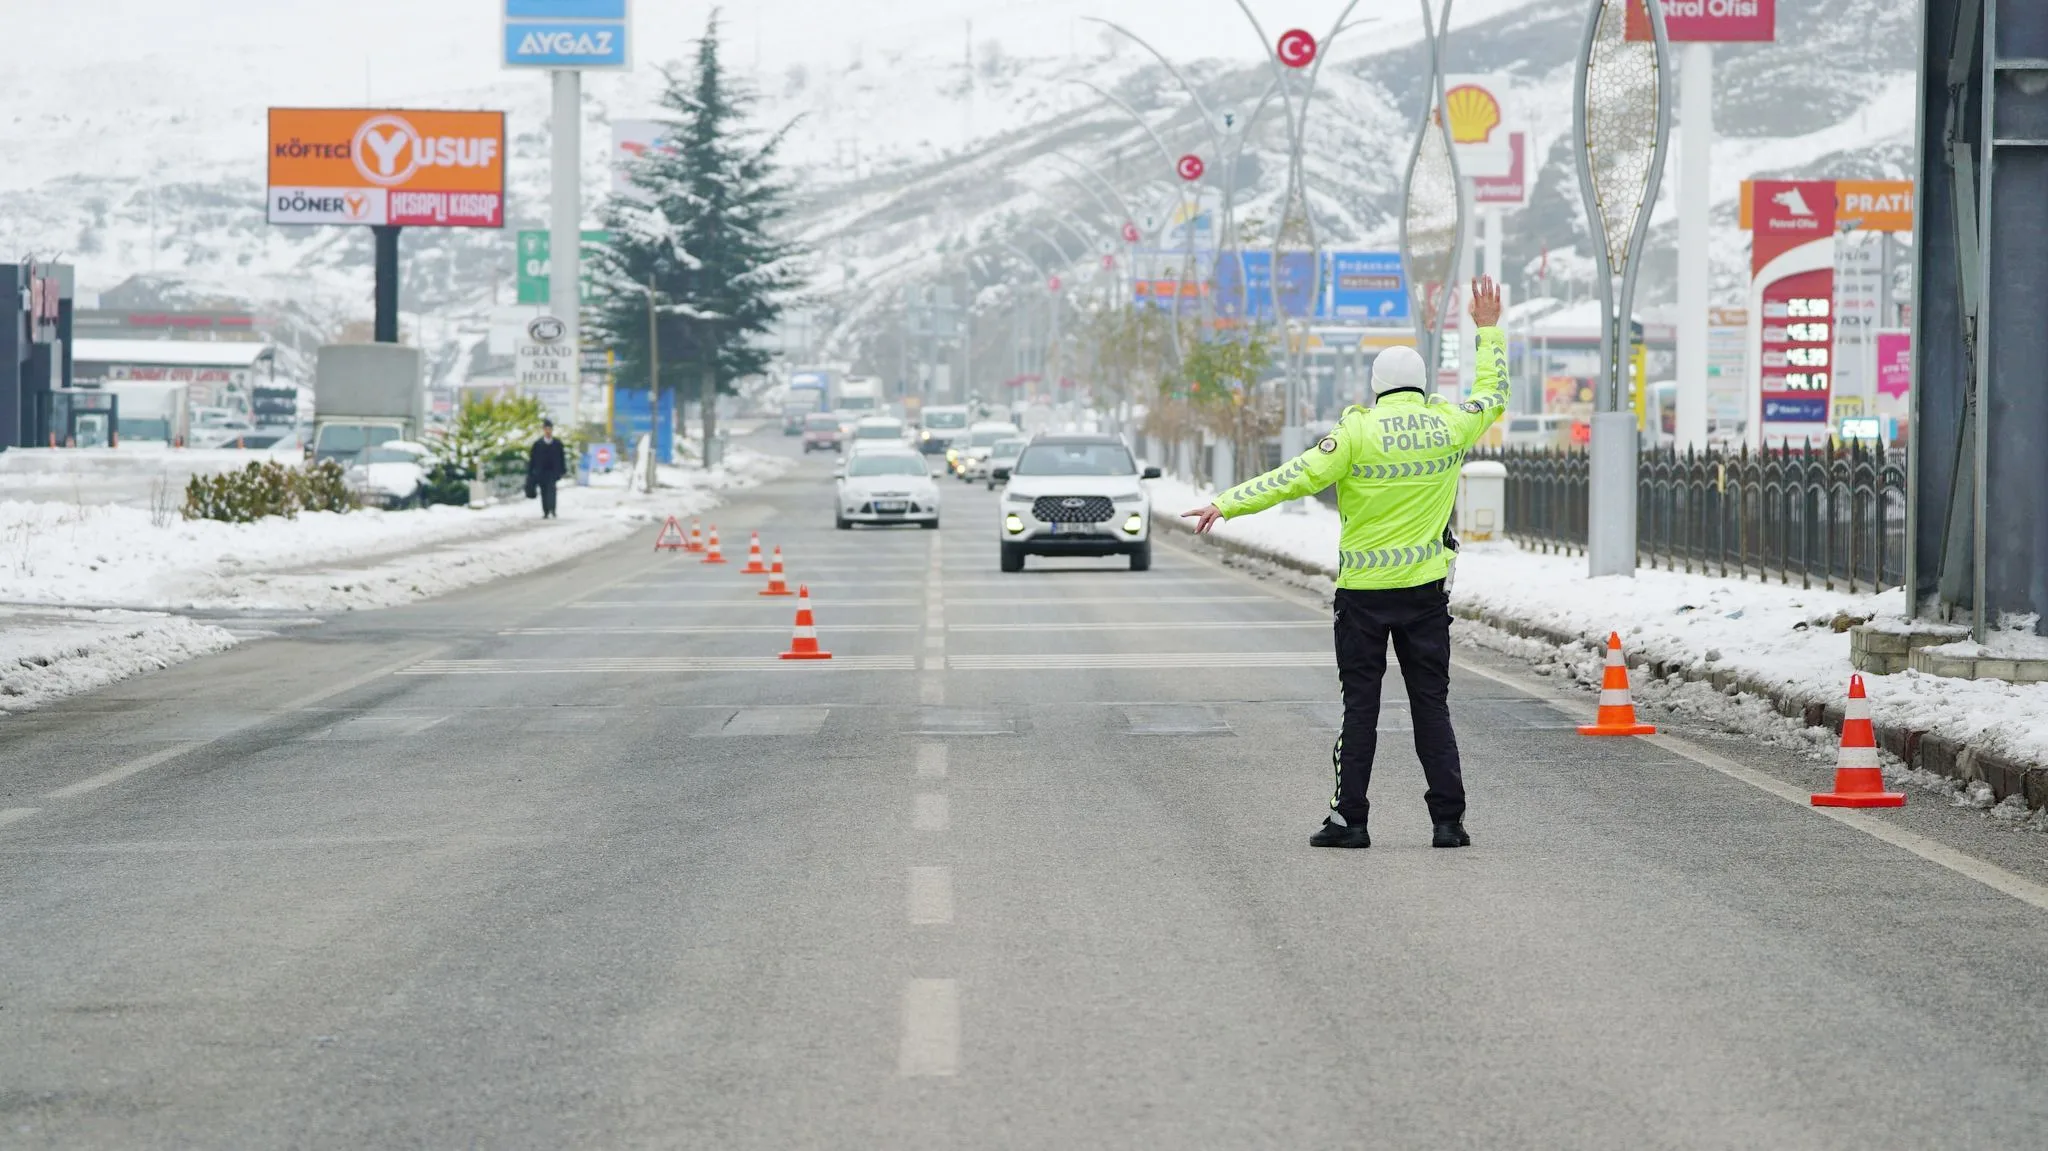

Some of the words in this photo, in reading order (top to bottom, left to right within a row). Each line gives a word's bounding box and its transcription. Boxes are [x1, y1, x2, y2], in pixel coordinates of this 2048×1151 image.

[517, 32, 613, 55] AYGAZ
[275, 137, 351, 159] KÖFTECİ
[366, 131, 497, 176] YUSUF
[278, 191, 344, 213] DÖNER
[449, 194, 498, 222] KASAP
[1845, 193, 1914, 213] PRATİ
[1769, 218, 1796, 229] Petrol
[521, 347, 571, 357] GRAND
[523, 371, 568, 384] HOTEL
[1383, 429, 1451, 453] POLİSİ
